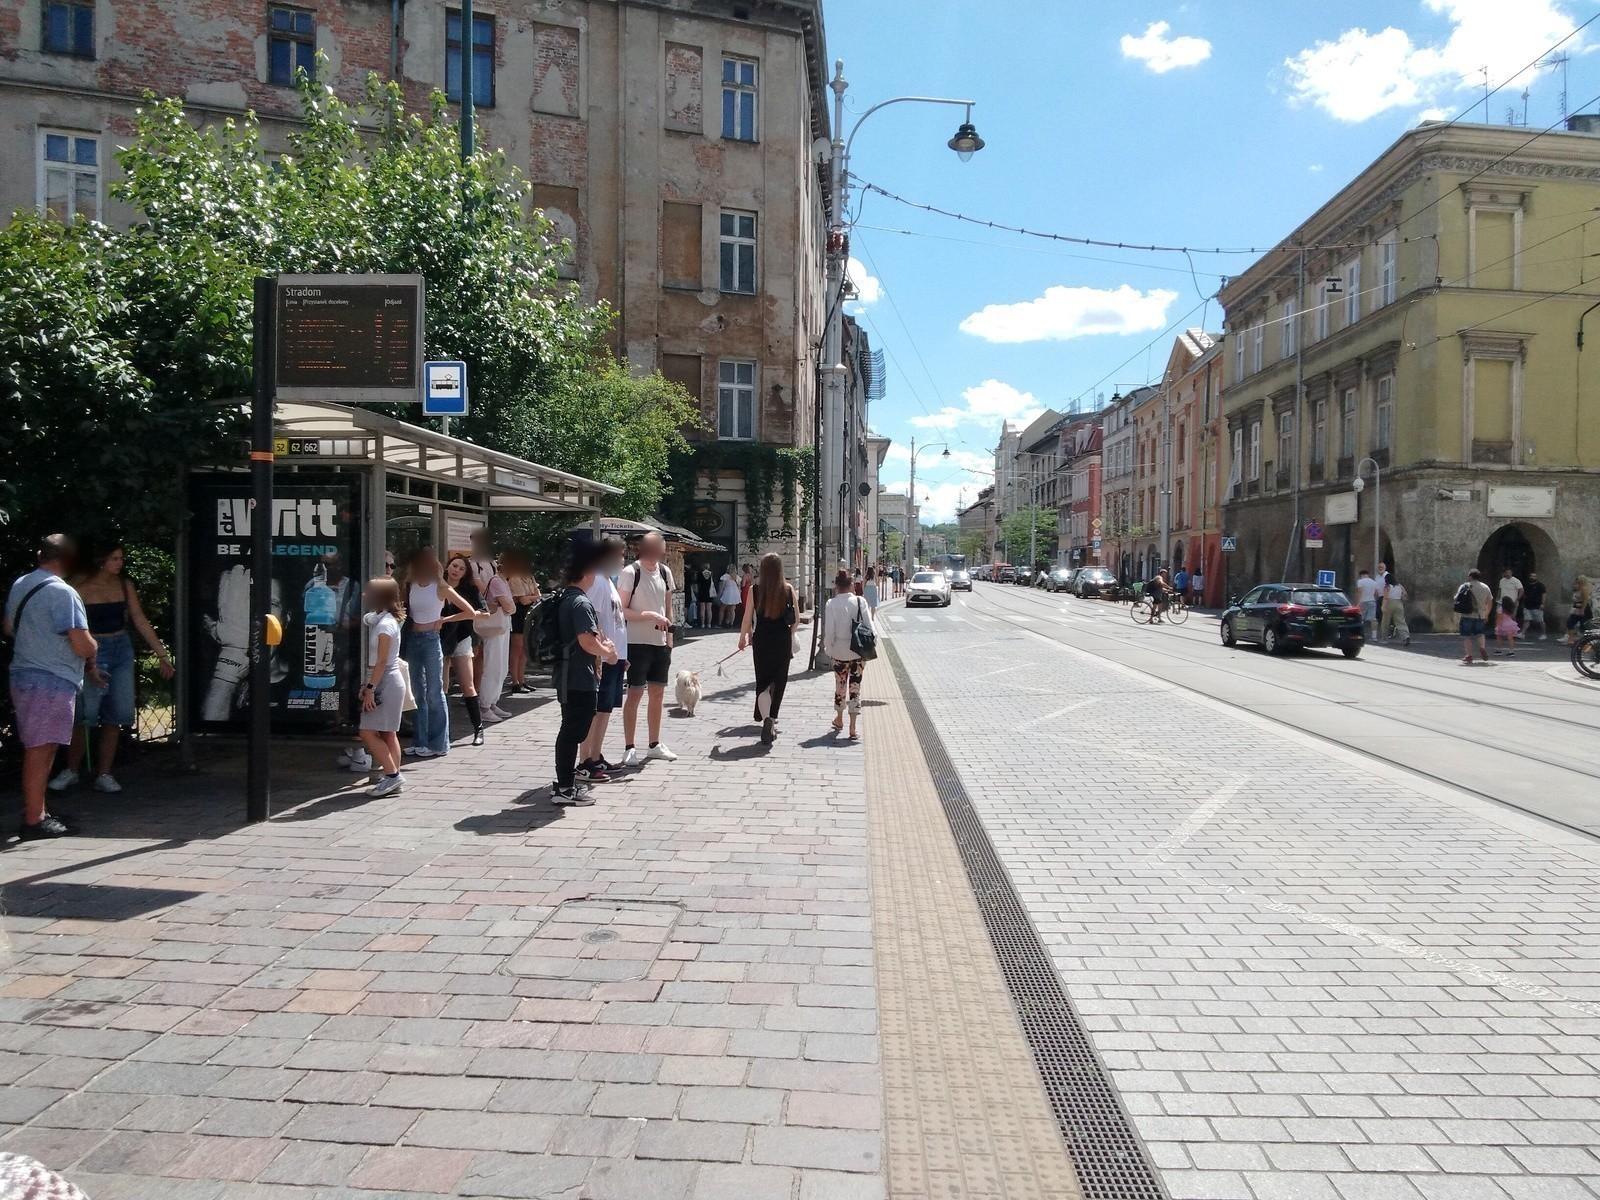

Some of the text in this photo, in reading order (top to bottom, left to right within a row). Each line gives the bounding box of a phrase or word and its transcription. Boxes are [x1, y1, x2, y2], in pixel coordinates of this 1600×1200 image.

[286, 288, 321, 297] Stradom
[277, 443, 318, 452] 52 62 662
[217, 544, 240, 555] BE
[1323, 573, 1331, 584] L
